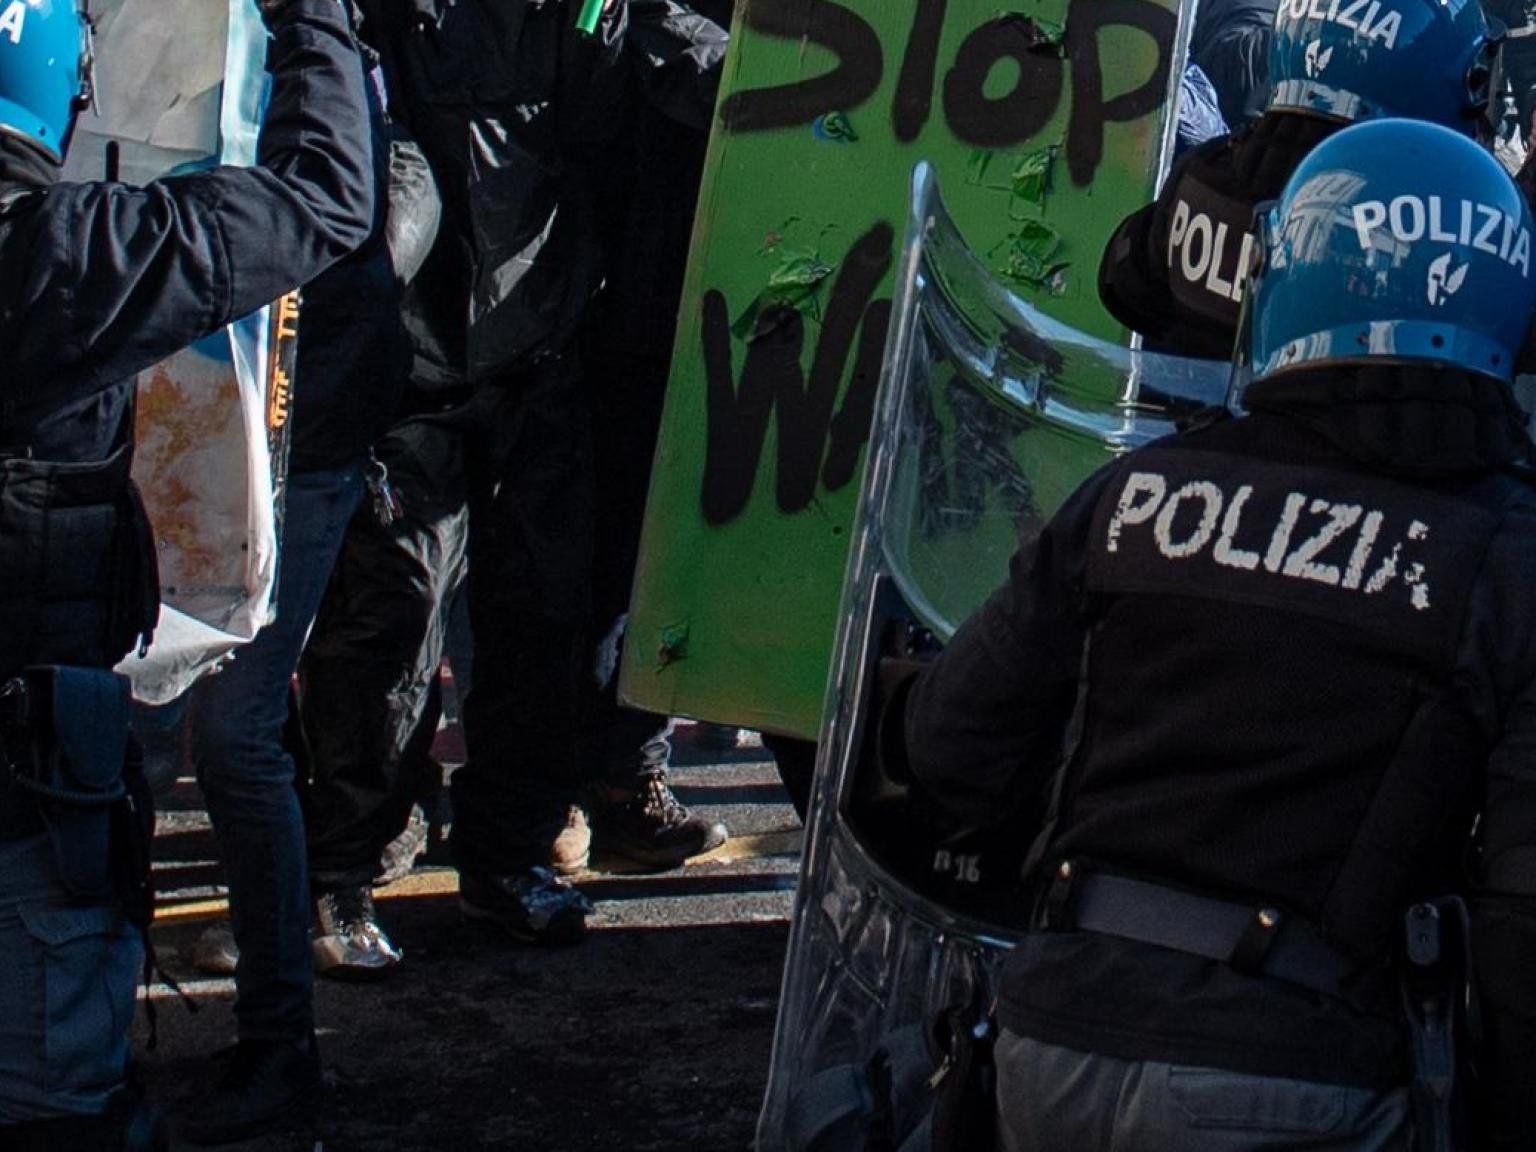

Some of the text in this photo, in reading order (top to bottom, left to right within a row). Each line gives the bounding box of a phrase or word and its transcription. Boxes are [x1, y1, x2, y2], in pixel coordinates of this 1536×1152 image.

[1168, 199, 1255, 303] POLI
[1352, 194, 1530, 278] POLIZIA
[1107, 472, 1430, 610] POLIZIA
